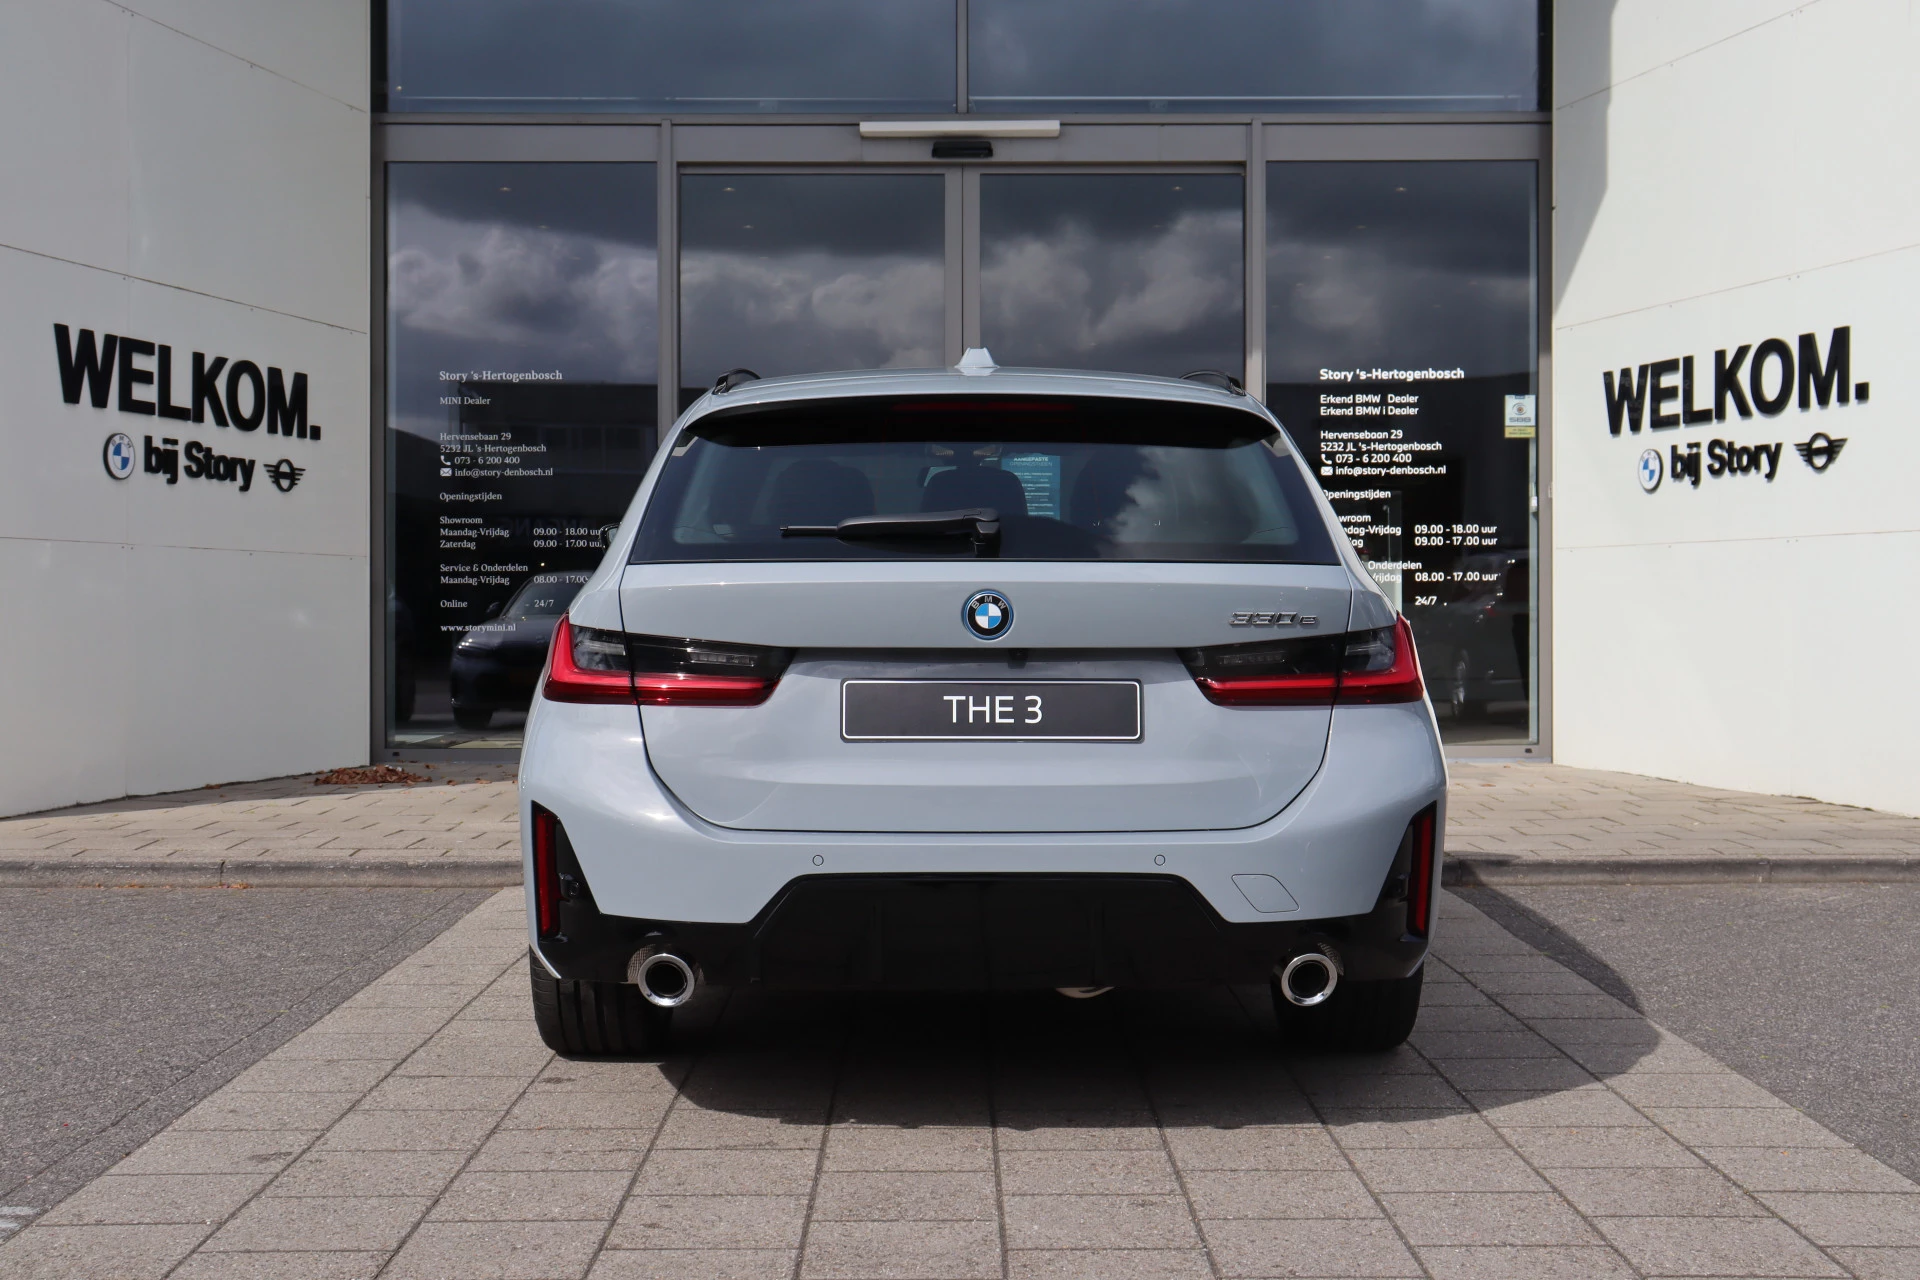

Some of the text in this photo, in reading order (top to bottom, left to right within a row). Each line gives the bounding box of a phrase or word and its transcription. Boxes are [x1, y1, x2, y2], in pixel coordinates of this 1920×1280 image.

[440, 370, 562, 382] Story 's-Hertogenbosch
[1320, 368, 1464, 381] Story 's-Hertogenbosch
[54, 323, 321, 440] WELKOM.
[1603, 325, 1869, 436] WELKOM.
[1321, 394, 1418, 403] Erkend BMW Dealer
[1321, 406, 1419, 415] Erkend BMW i Dealer
[1321, 430, 1403, 439] Hervensebaan 29
[463, 445, 473, 453] JL
[476, 445, 546, 453] 's-Hertogenbosch
[1321, 442, 1442, 452] 5232 JL 's-Hertogenbosch
[1336, 454, 1353, 463] 073
[1363, 454, 1369, 463] 6
[1371, 454, 1389, 462] 200
[1393, 454, 1412, 462] 400
[1671, 439, 1783, 486] bij Story
[144, 435, 256, 492] bij Story
[455, 468, 553, 478] info@story-denbosch.nl
[1336, 466, 1446, 476] info@story-denbosch.nl
[440, 492, 502, 502] Openingstijden
[440, 516, 482, 524] Showroom
[1339, 514, 1371, 522] wroom
[440, 528, 509, 537] Maandag-Vrijdag
[534, 528, 557, 536] 09.00
[565, 528, 587, 536] 18.00
[1346, 525, 1401, 535] dag-Vrijdag
[1415, 525, 1443, 534] 09.00
[1452, 525, 1479, 534] 18.00
[440, 540, 476, 549] Zaterdag
[1415, 537, 1444, 546] 09.00
[440, 564, 528, 572] Service & Onderdelen
[1368, 561, 1422, 570] Onderdelen
[441, 576, 509, 585] Maandag-Vrijdag
[534, 576, 557, 584] 08.00
[1415, 572, 1444, 581] 08.00
[441, 600, 554, 608] Online 24/7
[970, 596, 1008, 610] BMW
[1415, 596, 1437, 606] 24/7
[441, 624, 516, 633] www.storymini.nl
[943, 695, 1043, 724] THE 3
